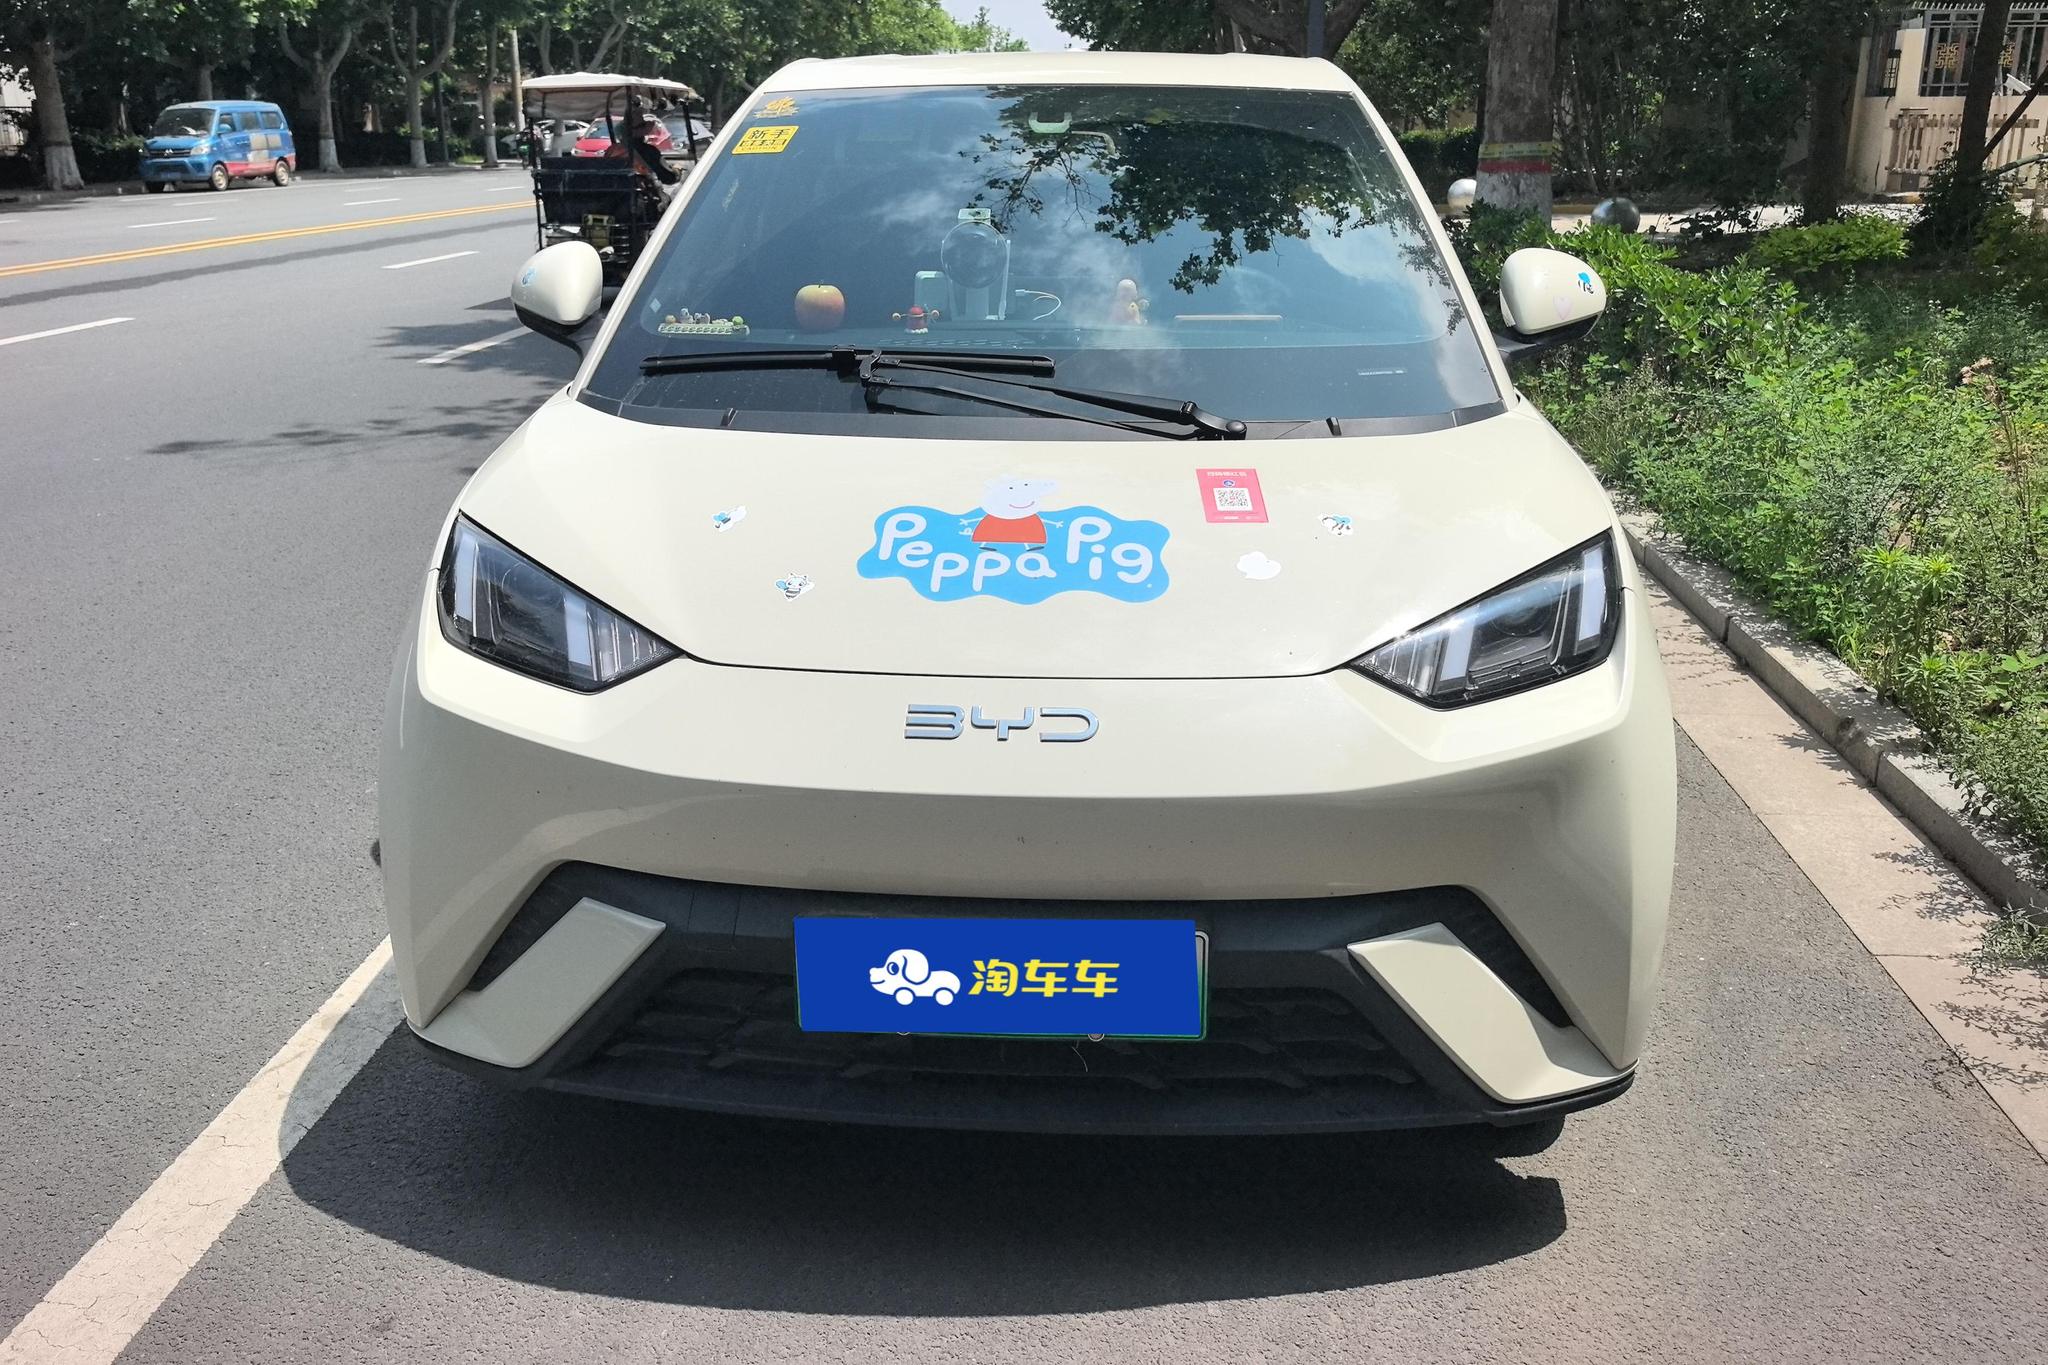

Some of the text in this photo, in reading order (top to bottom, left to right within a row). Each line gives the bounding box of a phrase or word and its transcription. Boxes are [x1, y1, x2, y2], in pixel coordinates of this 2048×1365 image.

[748, 129, 791, 140] 新手
[878, 512, 1153, 593] Peppa Pig
[904, 703, 1101, 743] BYD
